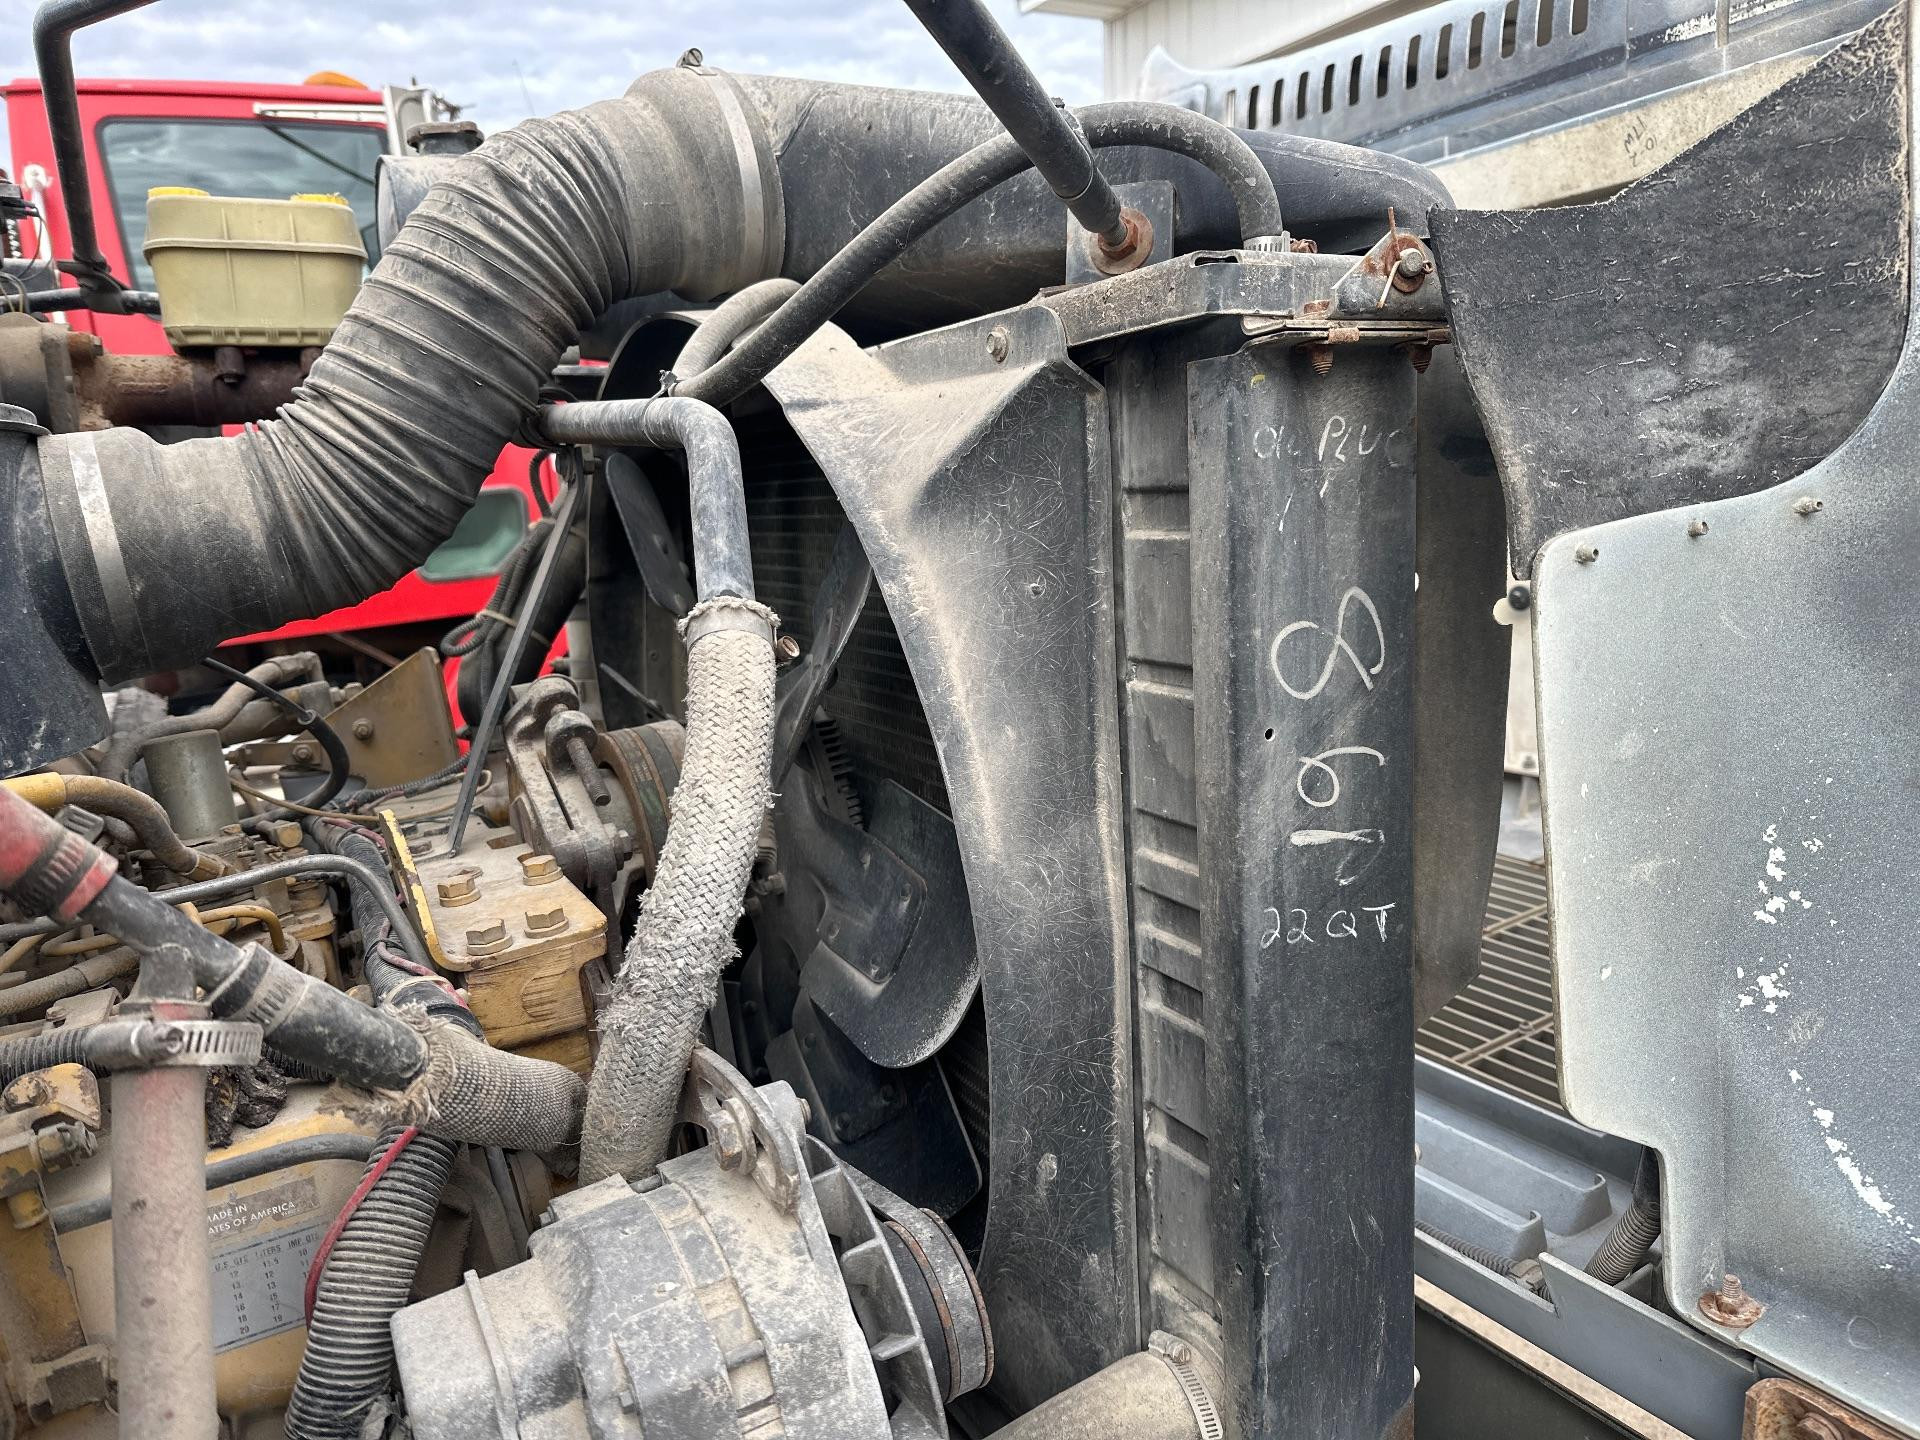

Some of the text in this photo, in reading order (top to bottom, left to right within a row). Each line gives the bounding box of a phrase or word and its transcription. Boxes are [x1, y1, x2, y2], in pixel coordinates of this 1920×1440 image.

[235, 1203, 248, 1214] IN
[207, 1222, 231, 1236] ATES
[233, 1216, 248, 1227] OF
[267, 1281, 277, 1290] 13
[234, 1292, 243, 1301] 14
[271, 1302, 280, 1311] 17
[238, 1314, 248, 1323] 18
[273, 1314, 283, 1323] 19
[240, 1325, 249, 1335] 20
